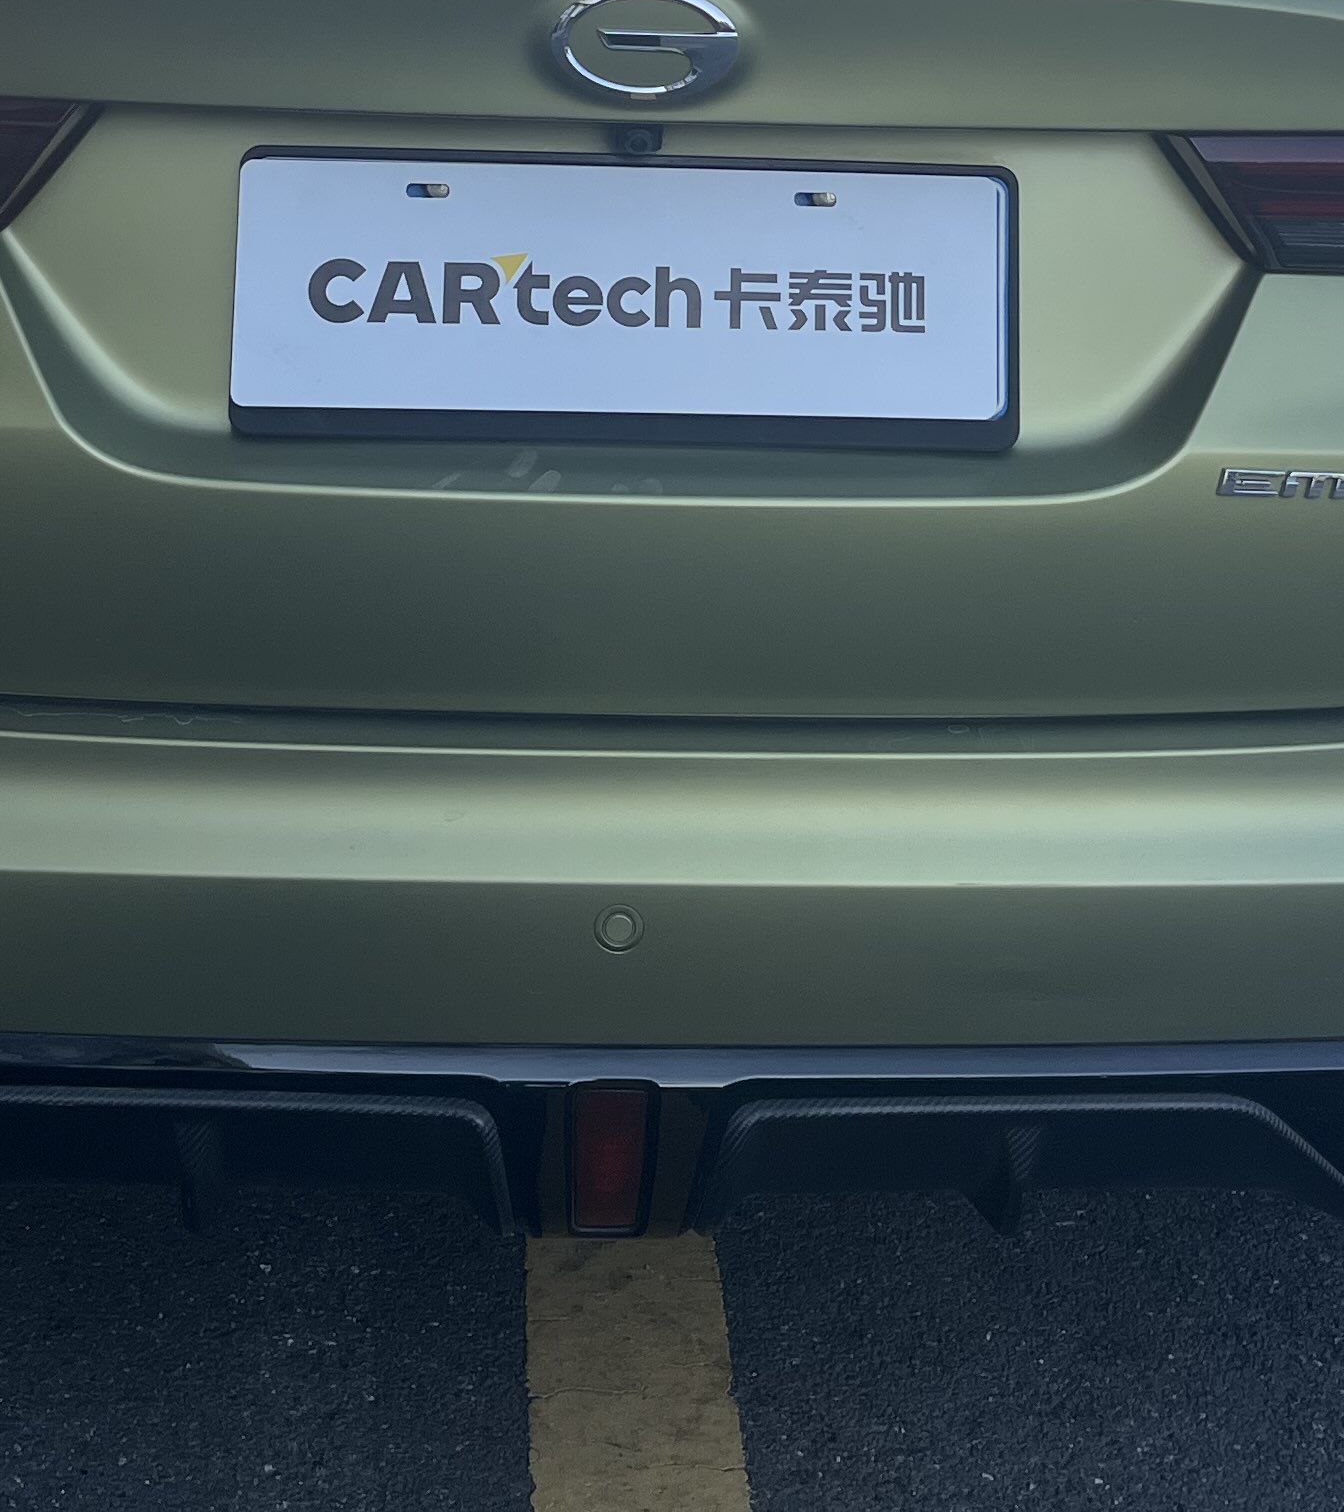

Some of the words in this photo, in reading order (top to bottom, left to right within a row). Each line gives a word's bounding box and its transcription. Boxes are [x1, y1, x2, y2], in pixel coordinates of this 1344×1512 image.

[308, 254, 702, 330] CARtech
[713, 267, 927, 335] 卡泰驰
